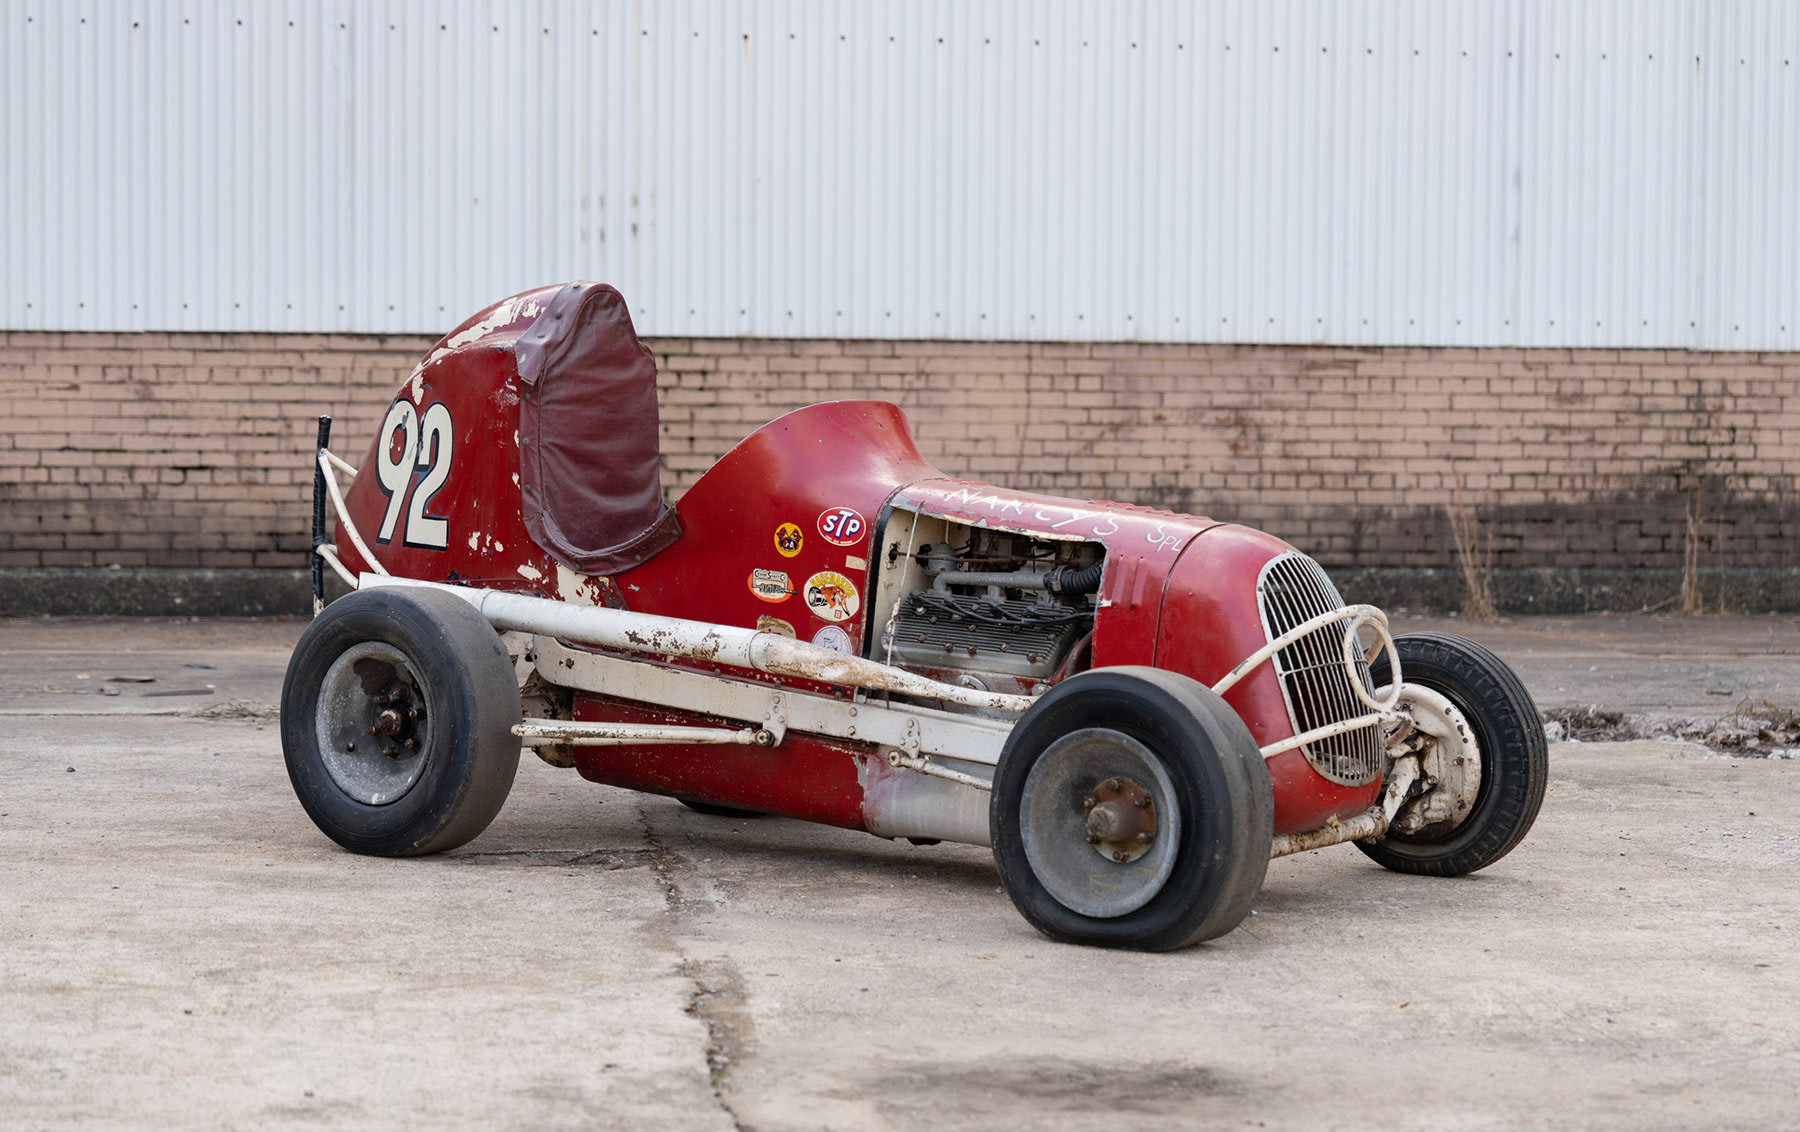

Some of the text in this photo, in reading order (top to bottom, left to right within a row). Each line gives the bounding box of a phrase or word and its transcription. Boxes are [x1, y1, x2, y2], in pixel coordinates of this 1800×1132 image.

[376, 398, 454, 551] 92
[822, 509, 862, 539] STP
[810, 572, 856, 599] RACEMASTER
